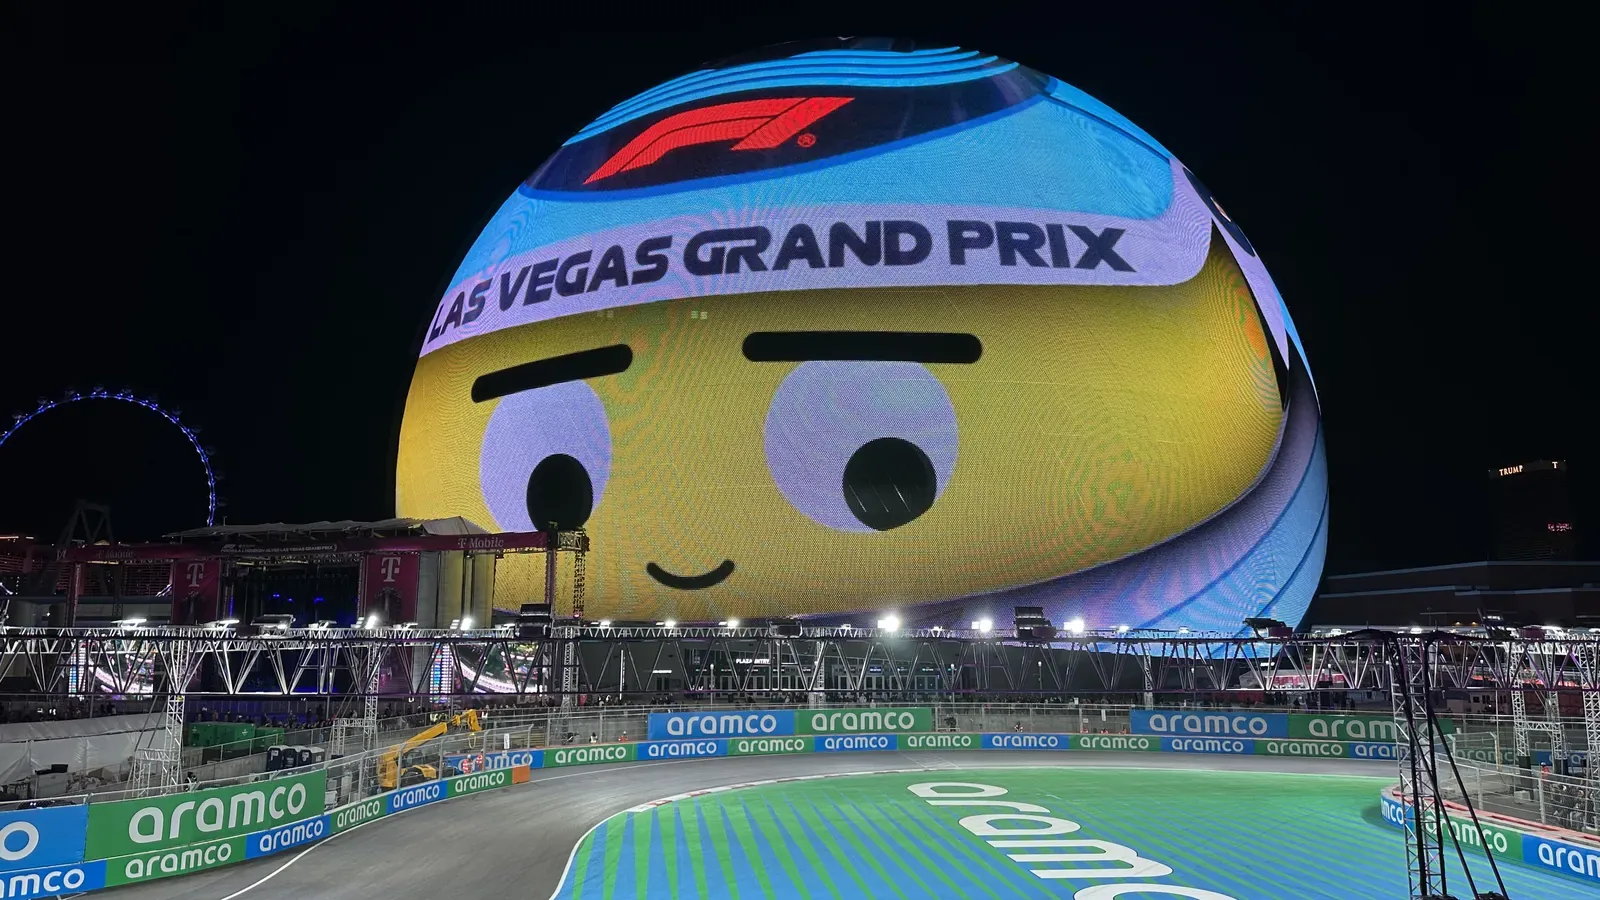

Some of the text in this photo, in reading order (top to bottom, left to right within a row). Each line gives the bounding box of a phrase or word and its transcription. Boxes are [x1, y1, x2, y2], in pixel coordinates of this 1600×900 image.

[427, 220, 1137, 344] LAS VEGAS GRAND PRIX
[1499, 464, 1524, 477] TRUMP
[666, 714, 777, 736] aramco
[812, 711, 915, 732] aramco
[1149, 713, 1268, 735] aramco
[649, 741, 717, 757] aramco
[738, 738, 805, 754] aramco
[825, 735, 889, 750] aramco
[907, 734, 972, 748] aramco
[992, 734, 1059, 748] aramco
[1079, 735, 1149, 750] aramco
[1171, 738, 1244, 753] aramco
[1266, 741, 1343, 757] aramco
[555, 746, 627, 764] aramco
[455, 771, 505, 793] aramco
[393, 784, 440, 809] aramco
[128, 782, 307, 844] aramco
[337, 800, 380, 828] aramco
[259, 819, 324, 852] aramco
[125, 843, 232, 879] aramco
